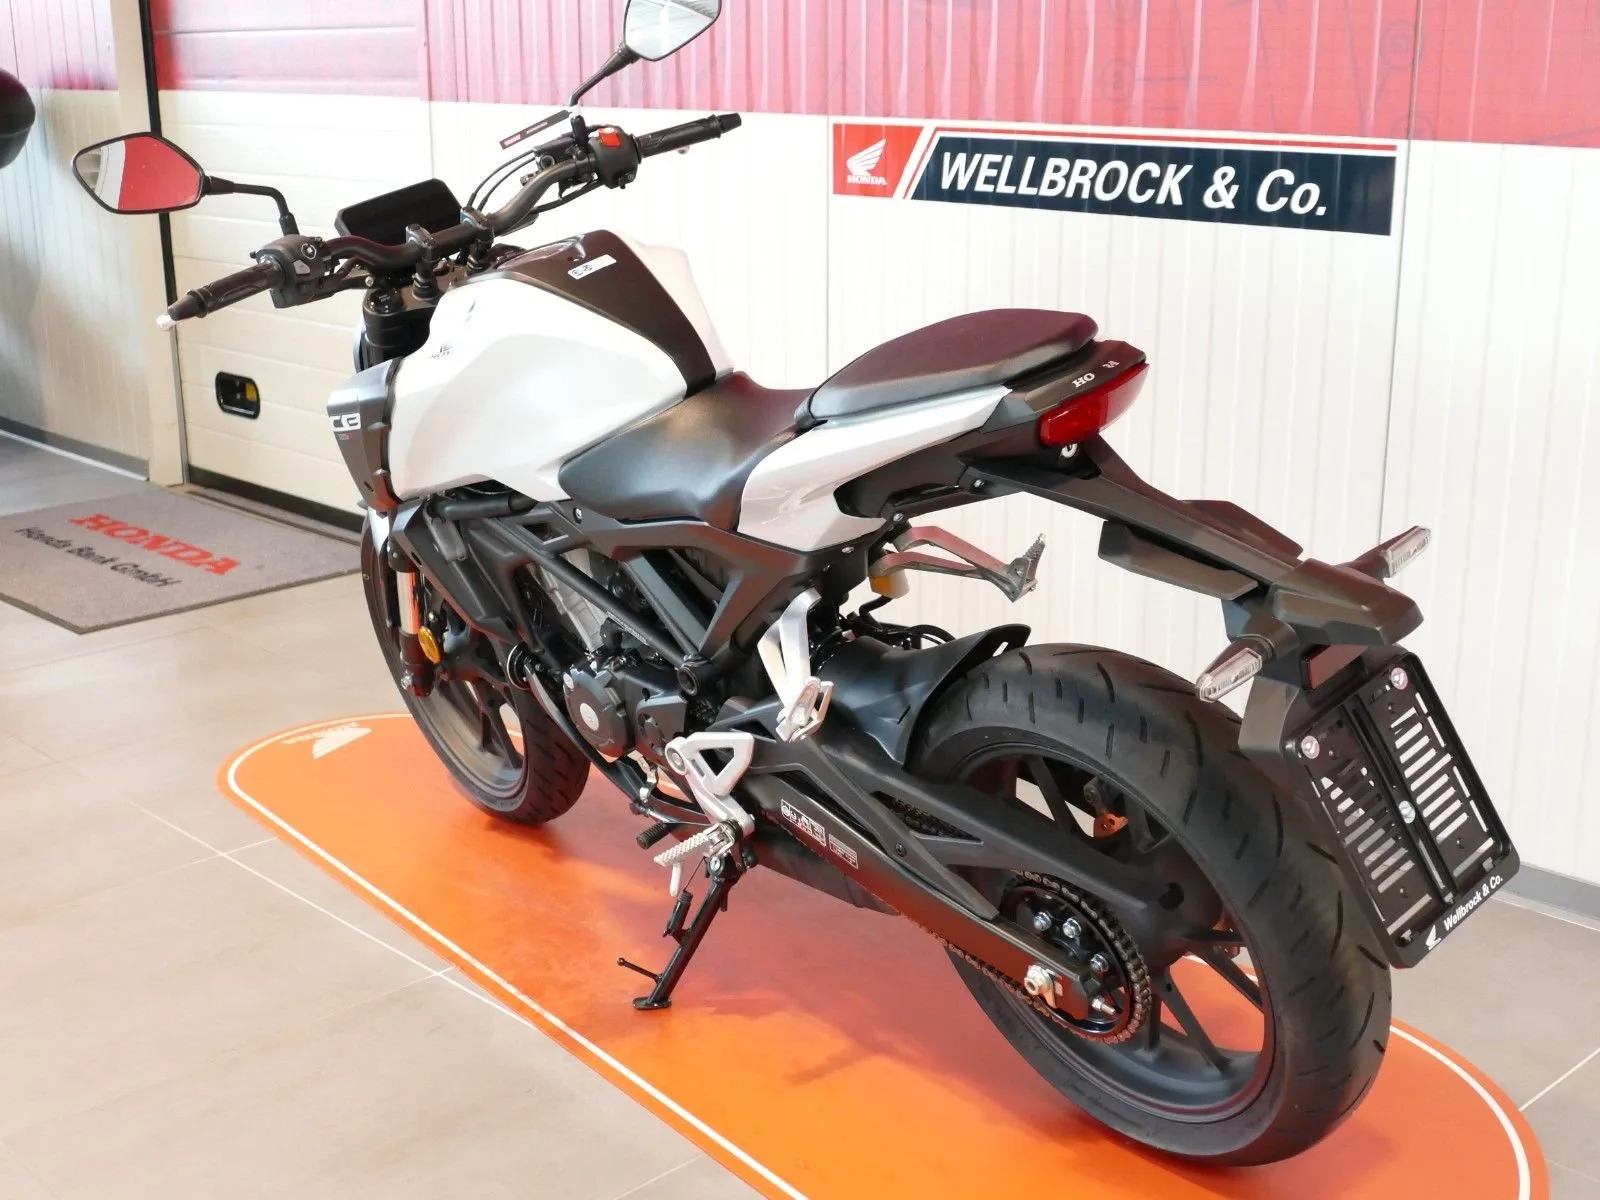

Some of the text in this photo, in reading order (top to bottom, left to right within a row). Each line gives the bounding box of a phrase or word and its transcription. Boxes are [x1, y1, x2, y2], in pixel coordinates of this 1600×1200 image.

[847, 174, 888, 186] HONDA
[940, 151, 1327, 216] WELLBROCK & Co.
[69, 512, 241, 576] HONDA
[1443, 874, 1503, 931] Wellbrock & Co.
